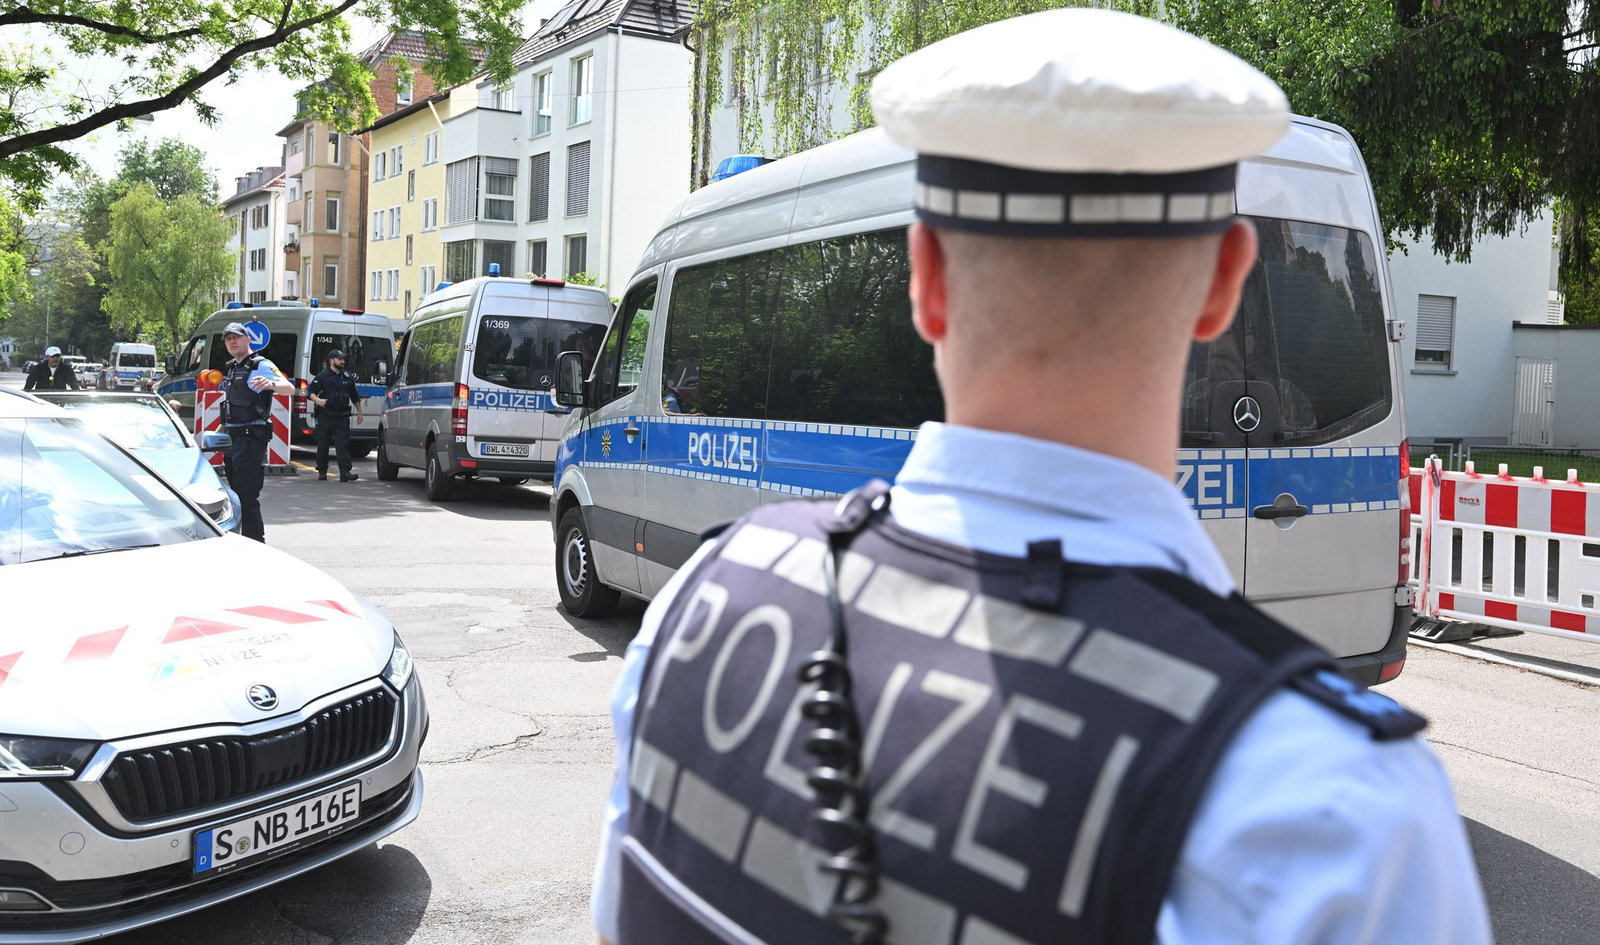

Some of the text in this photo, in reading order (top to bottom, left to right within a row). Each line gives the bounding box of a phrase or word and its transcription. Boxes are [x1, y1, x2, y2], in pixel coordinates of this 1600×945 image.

[485, 319, 510, 329] 1/369
[316, 336, 334, 344] 1/342
[473, 391, 540, 410] POLIZEI
[486, 445, 499, 454] BWL
[510, 446, 528, 455] 4320
[688, 431, 758, 473] POLIZEI
[203, 648, 262, 668] NETZE
[646, 580, 1140, 918] POLIZEI
[215, 788, 358, 861] S NB 116E
